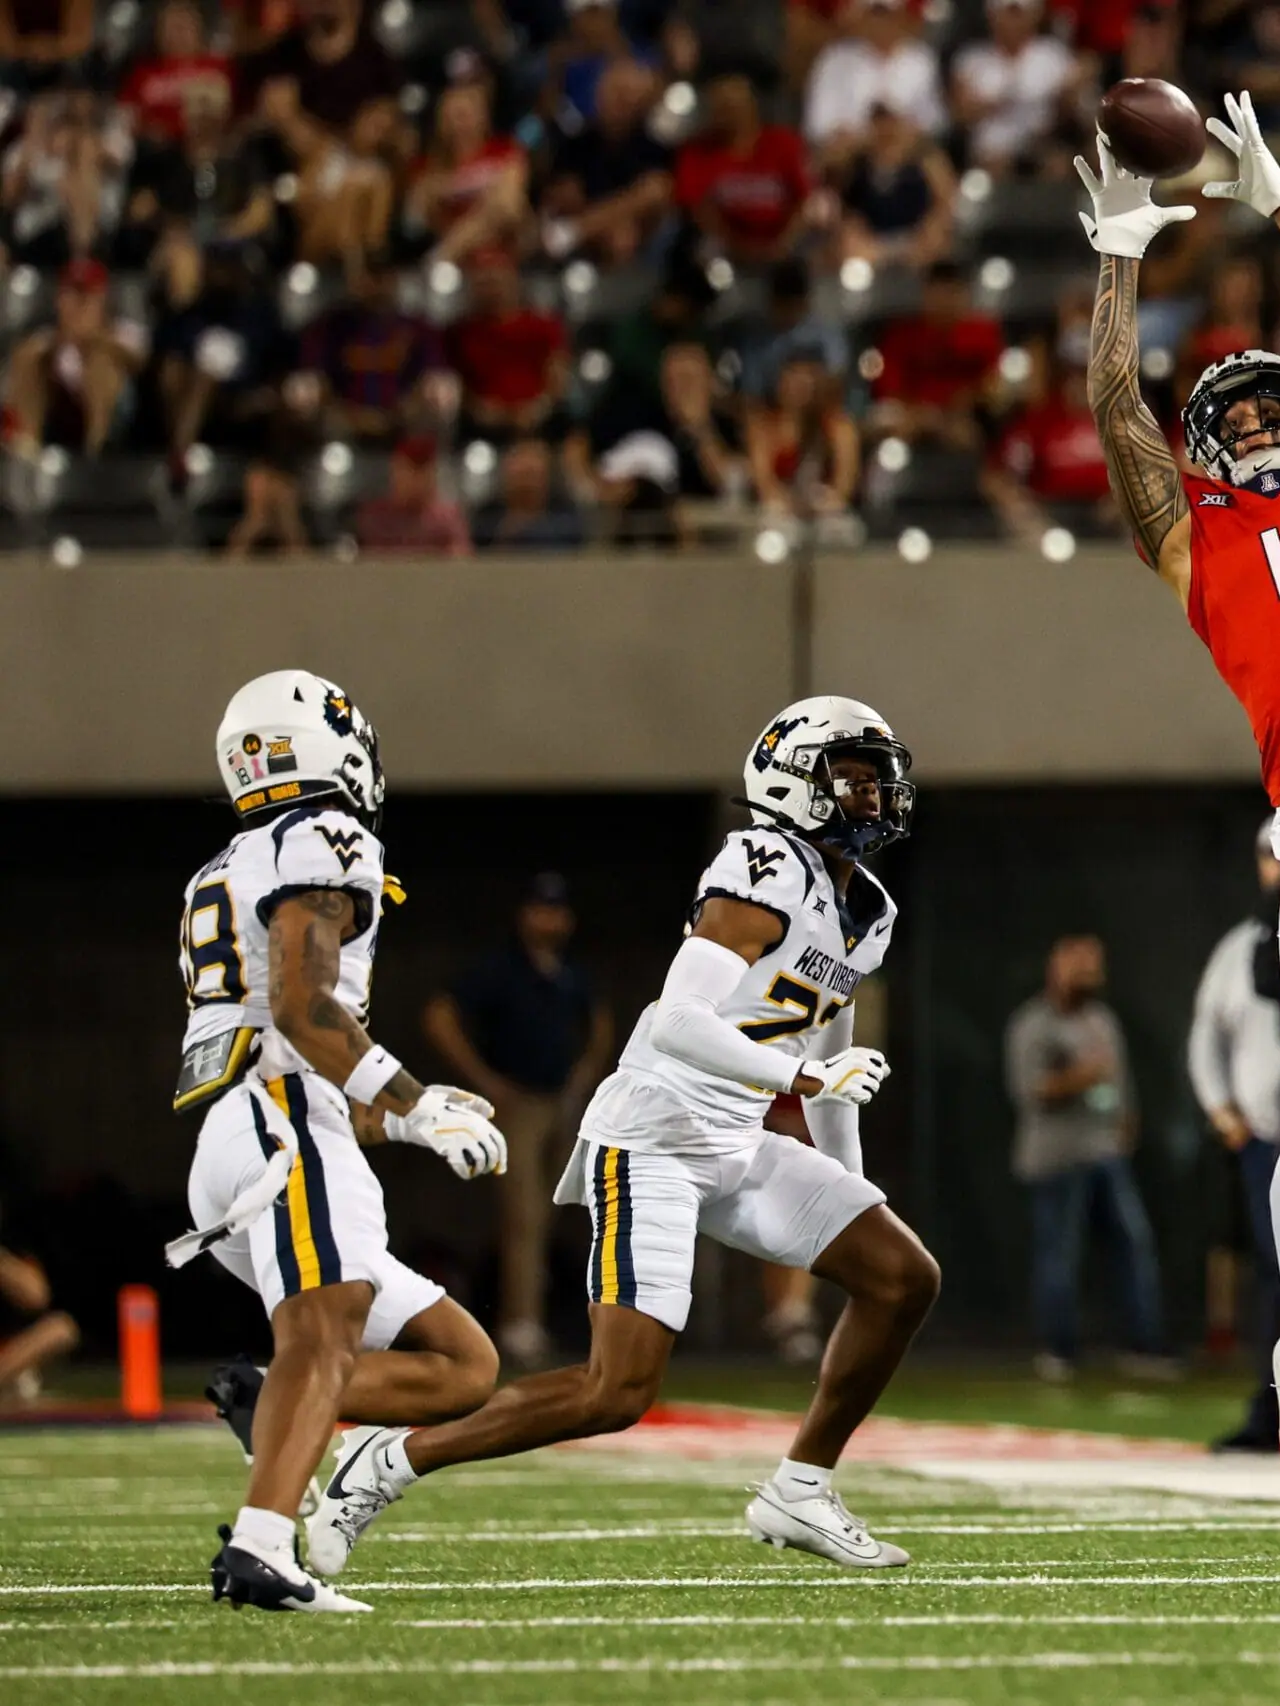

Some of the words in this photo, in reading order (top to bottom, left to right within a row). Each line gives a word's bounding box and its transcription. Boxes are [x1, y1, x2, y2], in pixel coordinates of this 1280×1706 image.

[1199, 493, 1231, 507] XII
[313, 824, 364, 873] WV
[742, 838, 787, 888] WV
[794, 945, 834, 984] WEST
